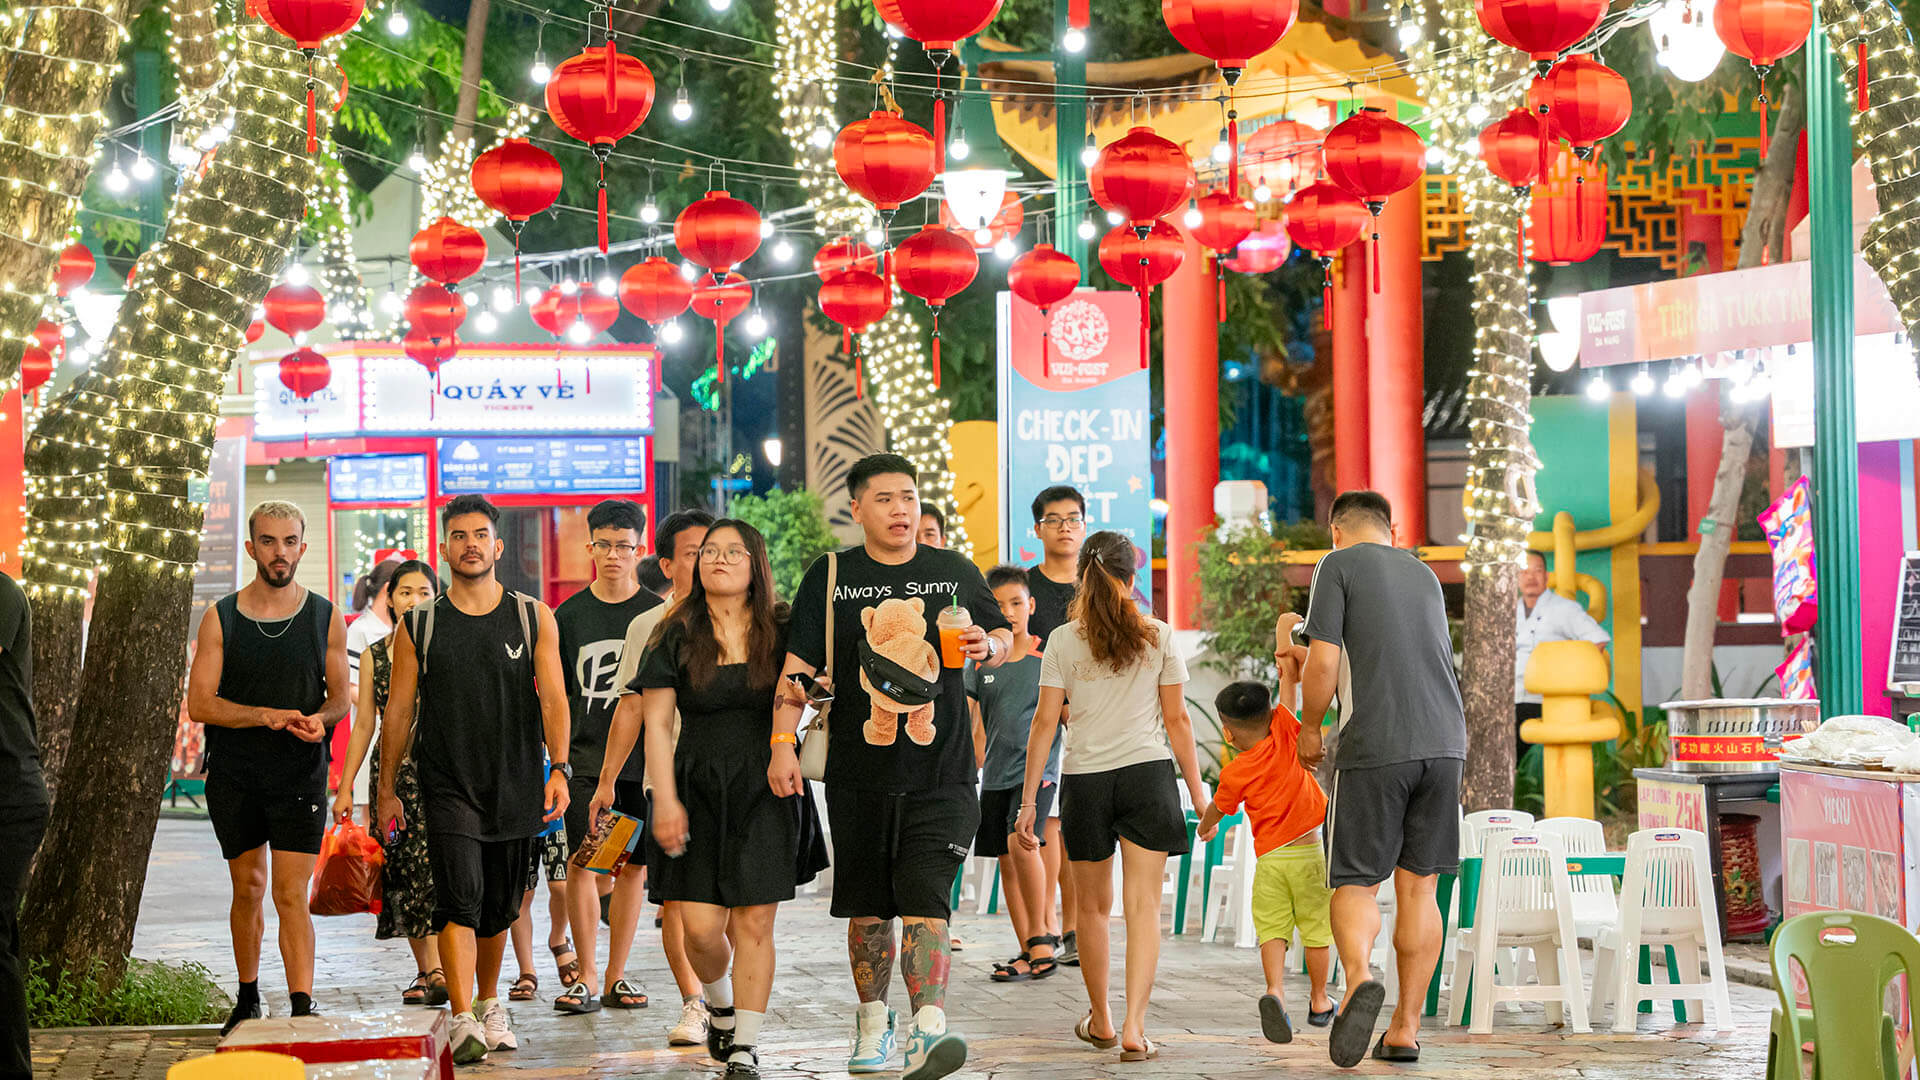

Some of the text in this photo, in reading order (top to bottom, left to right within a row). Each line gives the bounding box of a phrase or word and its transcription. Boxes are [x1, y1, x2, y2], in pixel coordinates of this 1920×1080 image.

[1017, 409, 1142, 441] CHECK-IN
[833, 581, 958, 602] Always Sunny
[1680, 743, 1782, 754] 多功能火山石烤
[1676, 792, 1704, 832] 25K
[1824, 795, 1850, 825] MENU
